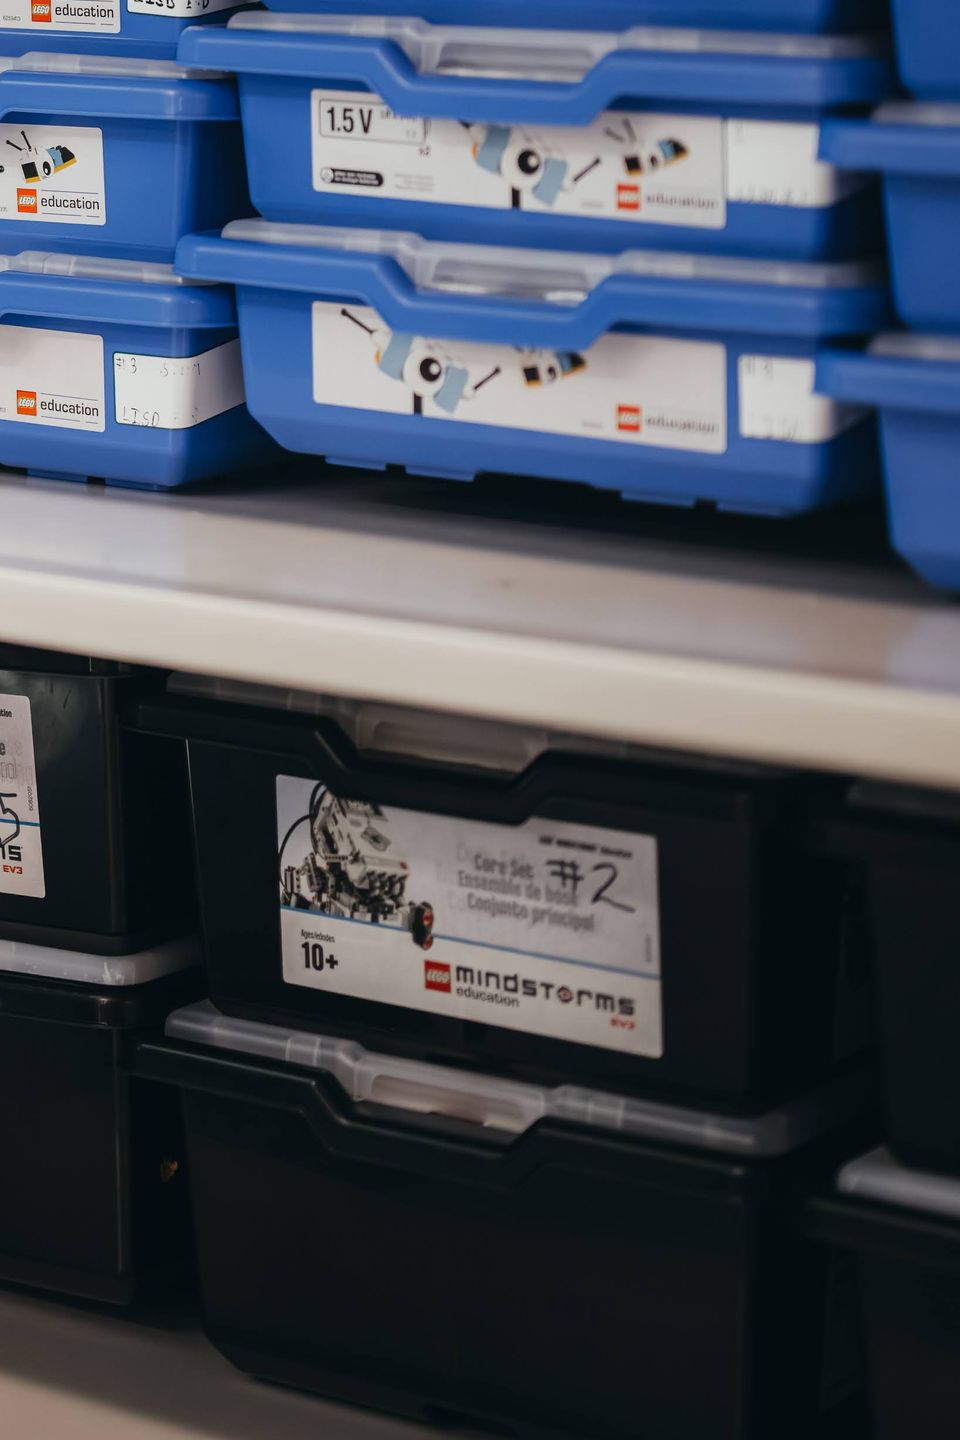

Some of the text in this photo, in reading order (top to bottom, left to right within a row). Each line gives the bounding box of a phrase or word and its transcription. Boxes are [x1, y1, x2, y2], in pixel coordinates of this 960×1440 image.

[55, 3, 114, 18] education
[327, 106, 372, 134] 1.5 V
[41, 195, 100, 210] education
[40, 399, 99, 417] education
[2, 864, 23, 875] EV3
[546, 860, 636, 913] #2
[301, 941, 339, 972] 10+
[456, 987, 520, 1008] education
